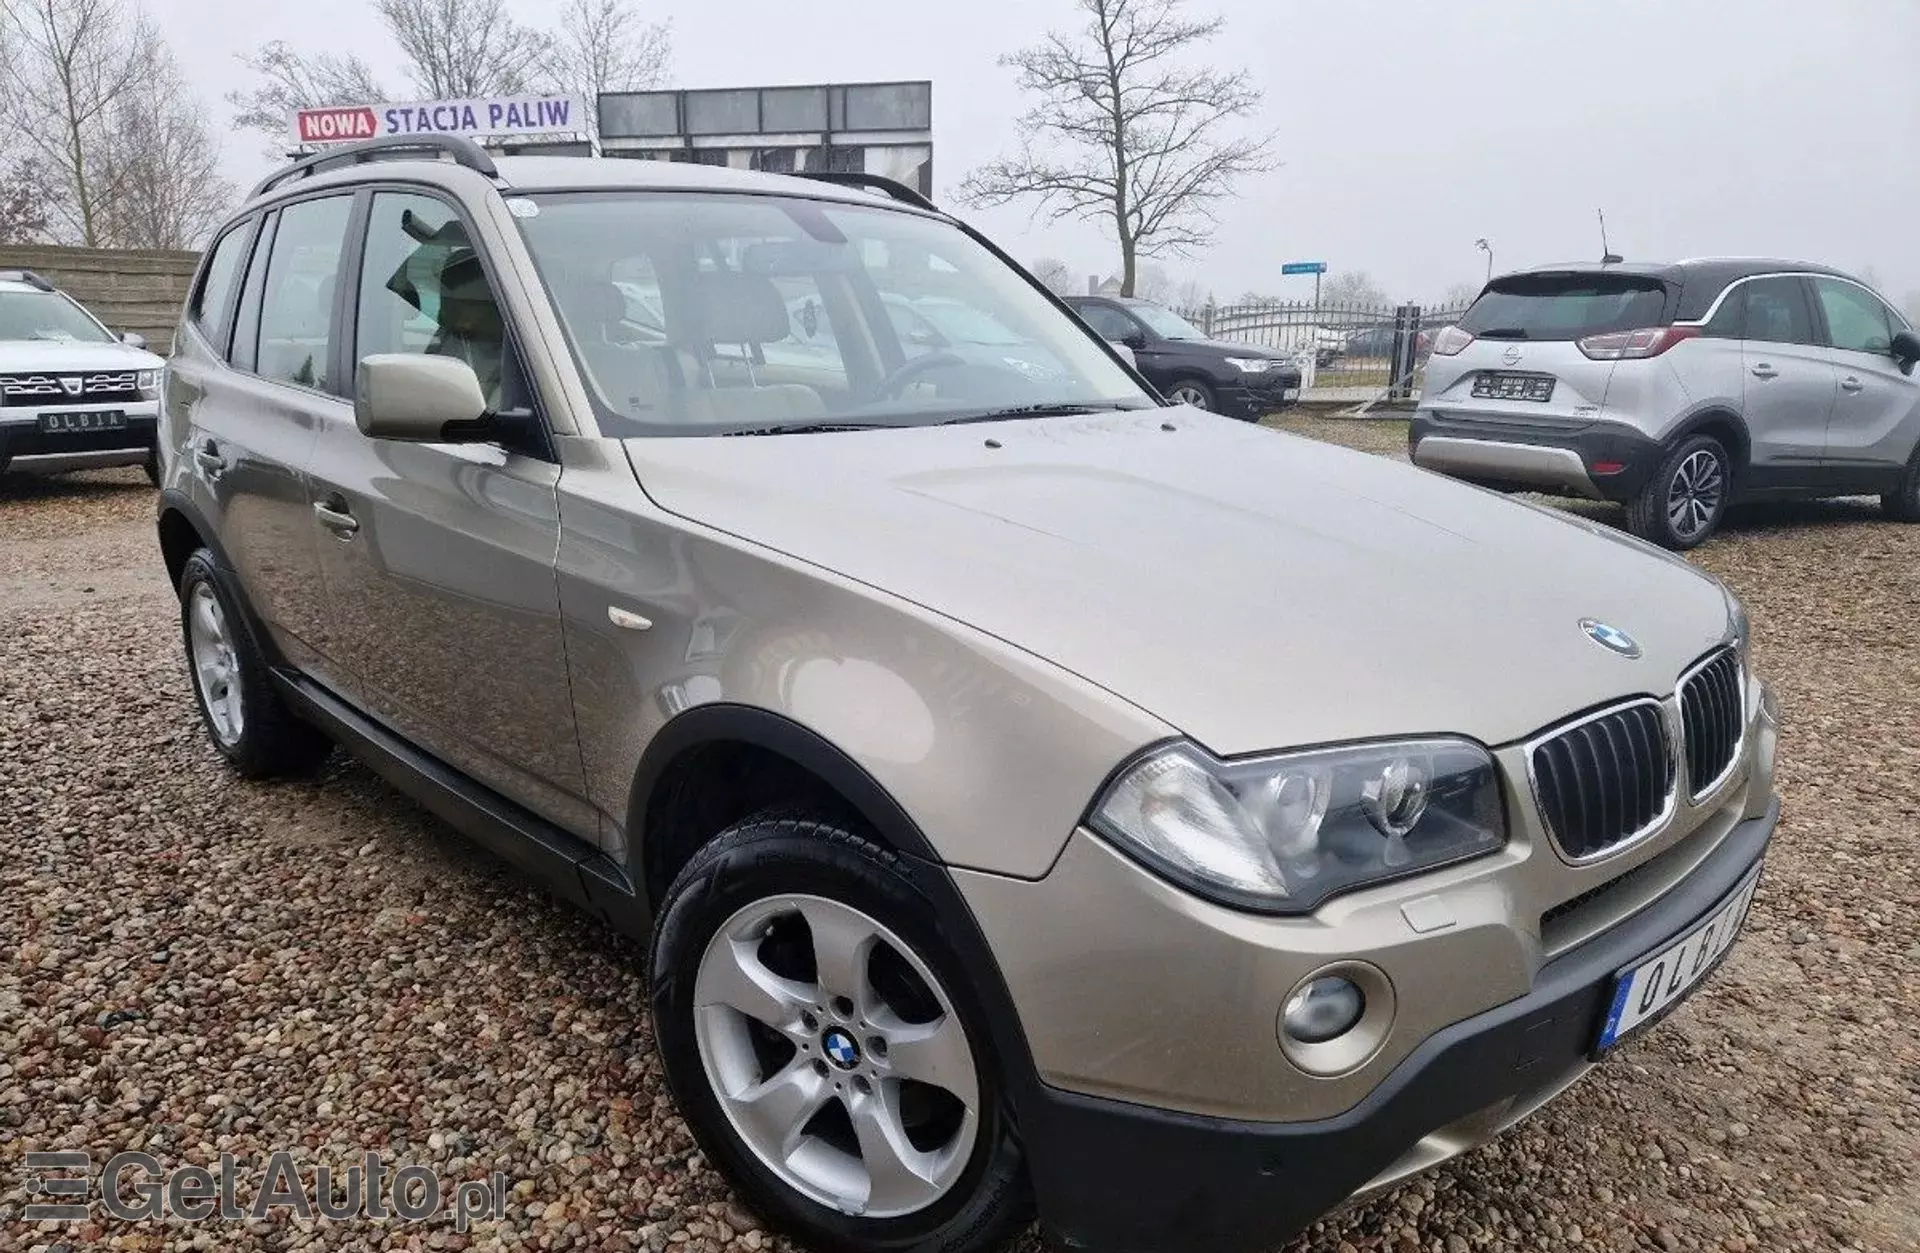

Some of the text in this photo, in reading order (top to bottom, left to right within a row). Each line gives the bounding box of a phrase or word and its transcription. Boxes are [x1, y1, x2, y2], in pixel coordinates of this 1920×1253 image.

[305, 100, 569, 137] NOWA STACJA PALIW
